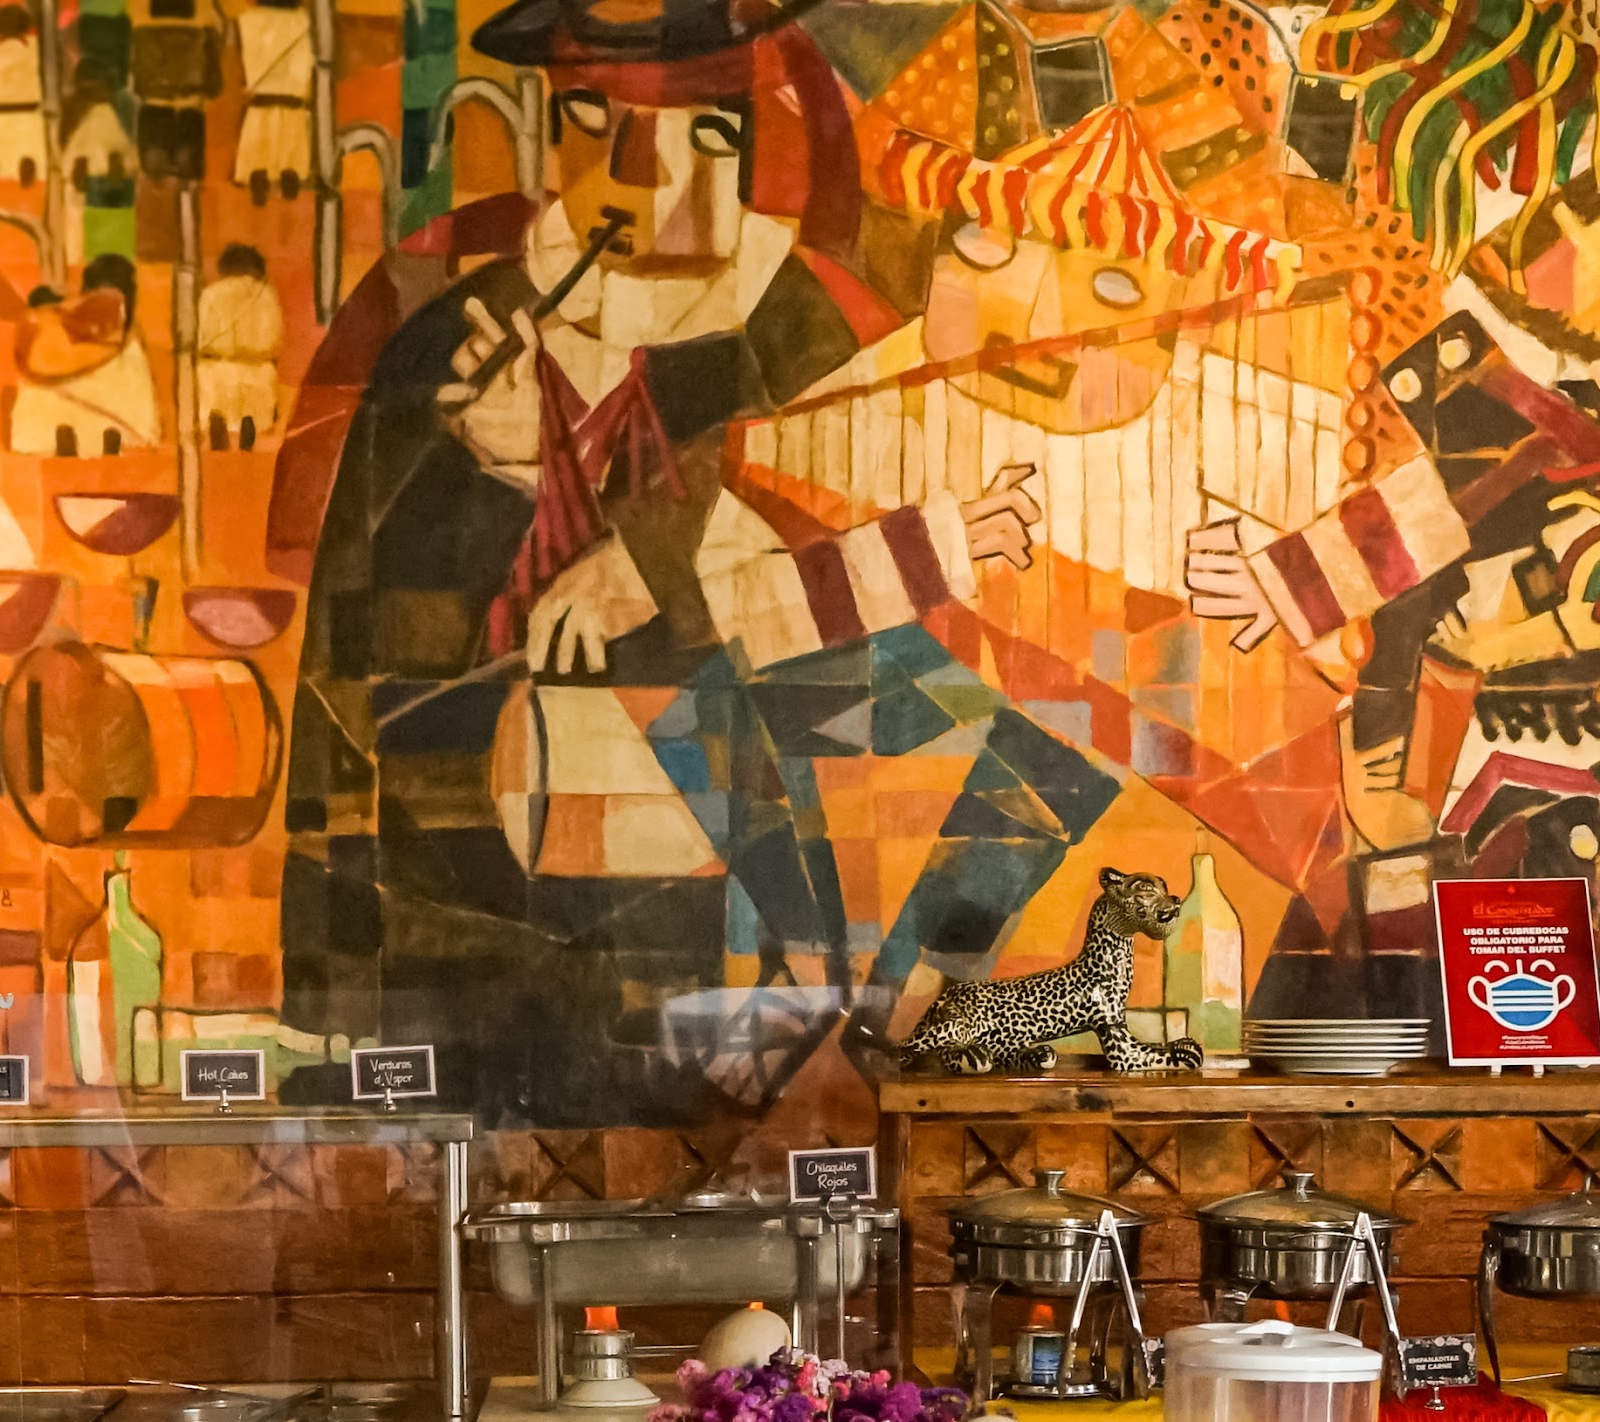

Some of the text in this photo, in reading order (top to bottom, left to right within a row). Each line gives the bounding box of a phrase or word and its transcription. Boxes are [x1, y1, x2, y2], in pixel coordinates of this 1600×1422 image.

[1463, 926, 1570, 936] USO DE CUBREBOCAS
[1470, 935, 1564, 945] OBLIGATORIO PARA
[1469, 945, 1566, 955] TOMAR DEL BUFFET
[369, 1058, 413, 1073] Verduras
[197, 1066, 249, 1082] Hot Cakes
[383, 1071, 414, 1087] Vapor
[817, 1173, 850, 1192] Rojos
[1415, 1363, 1426, 1371] DE
